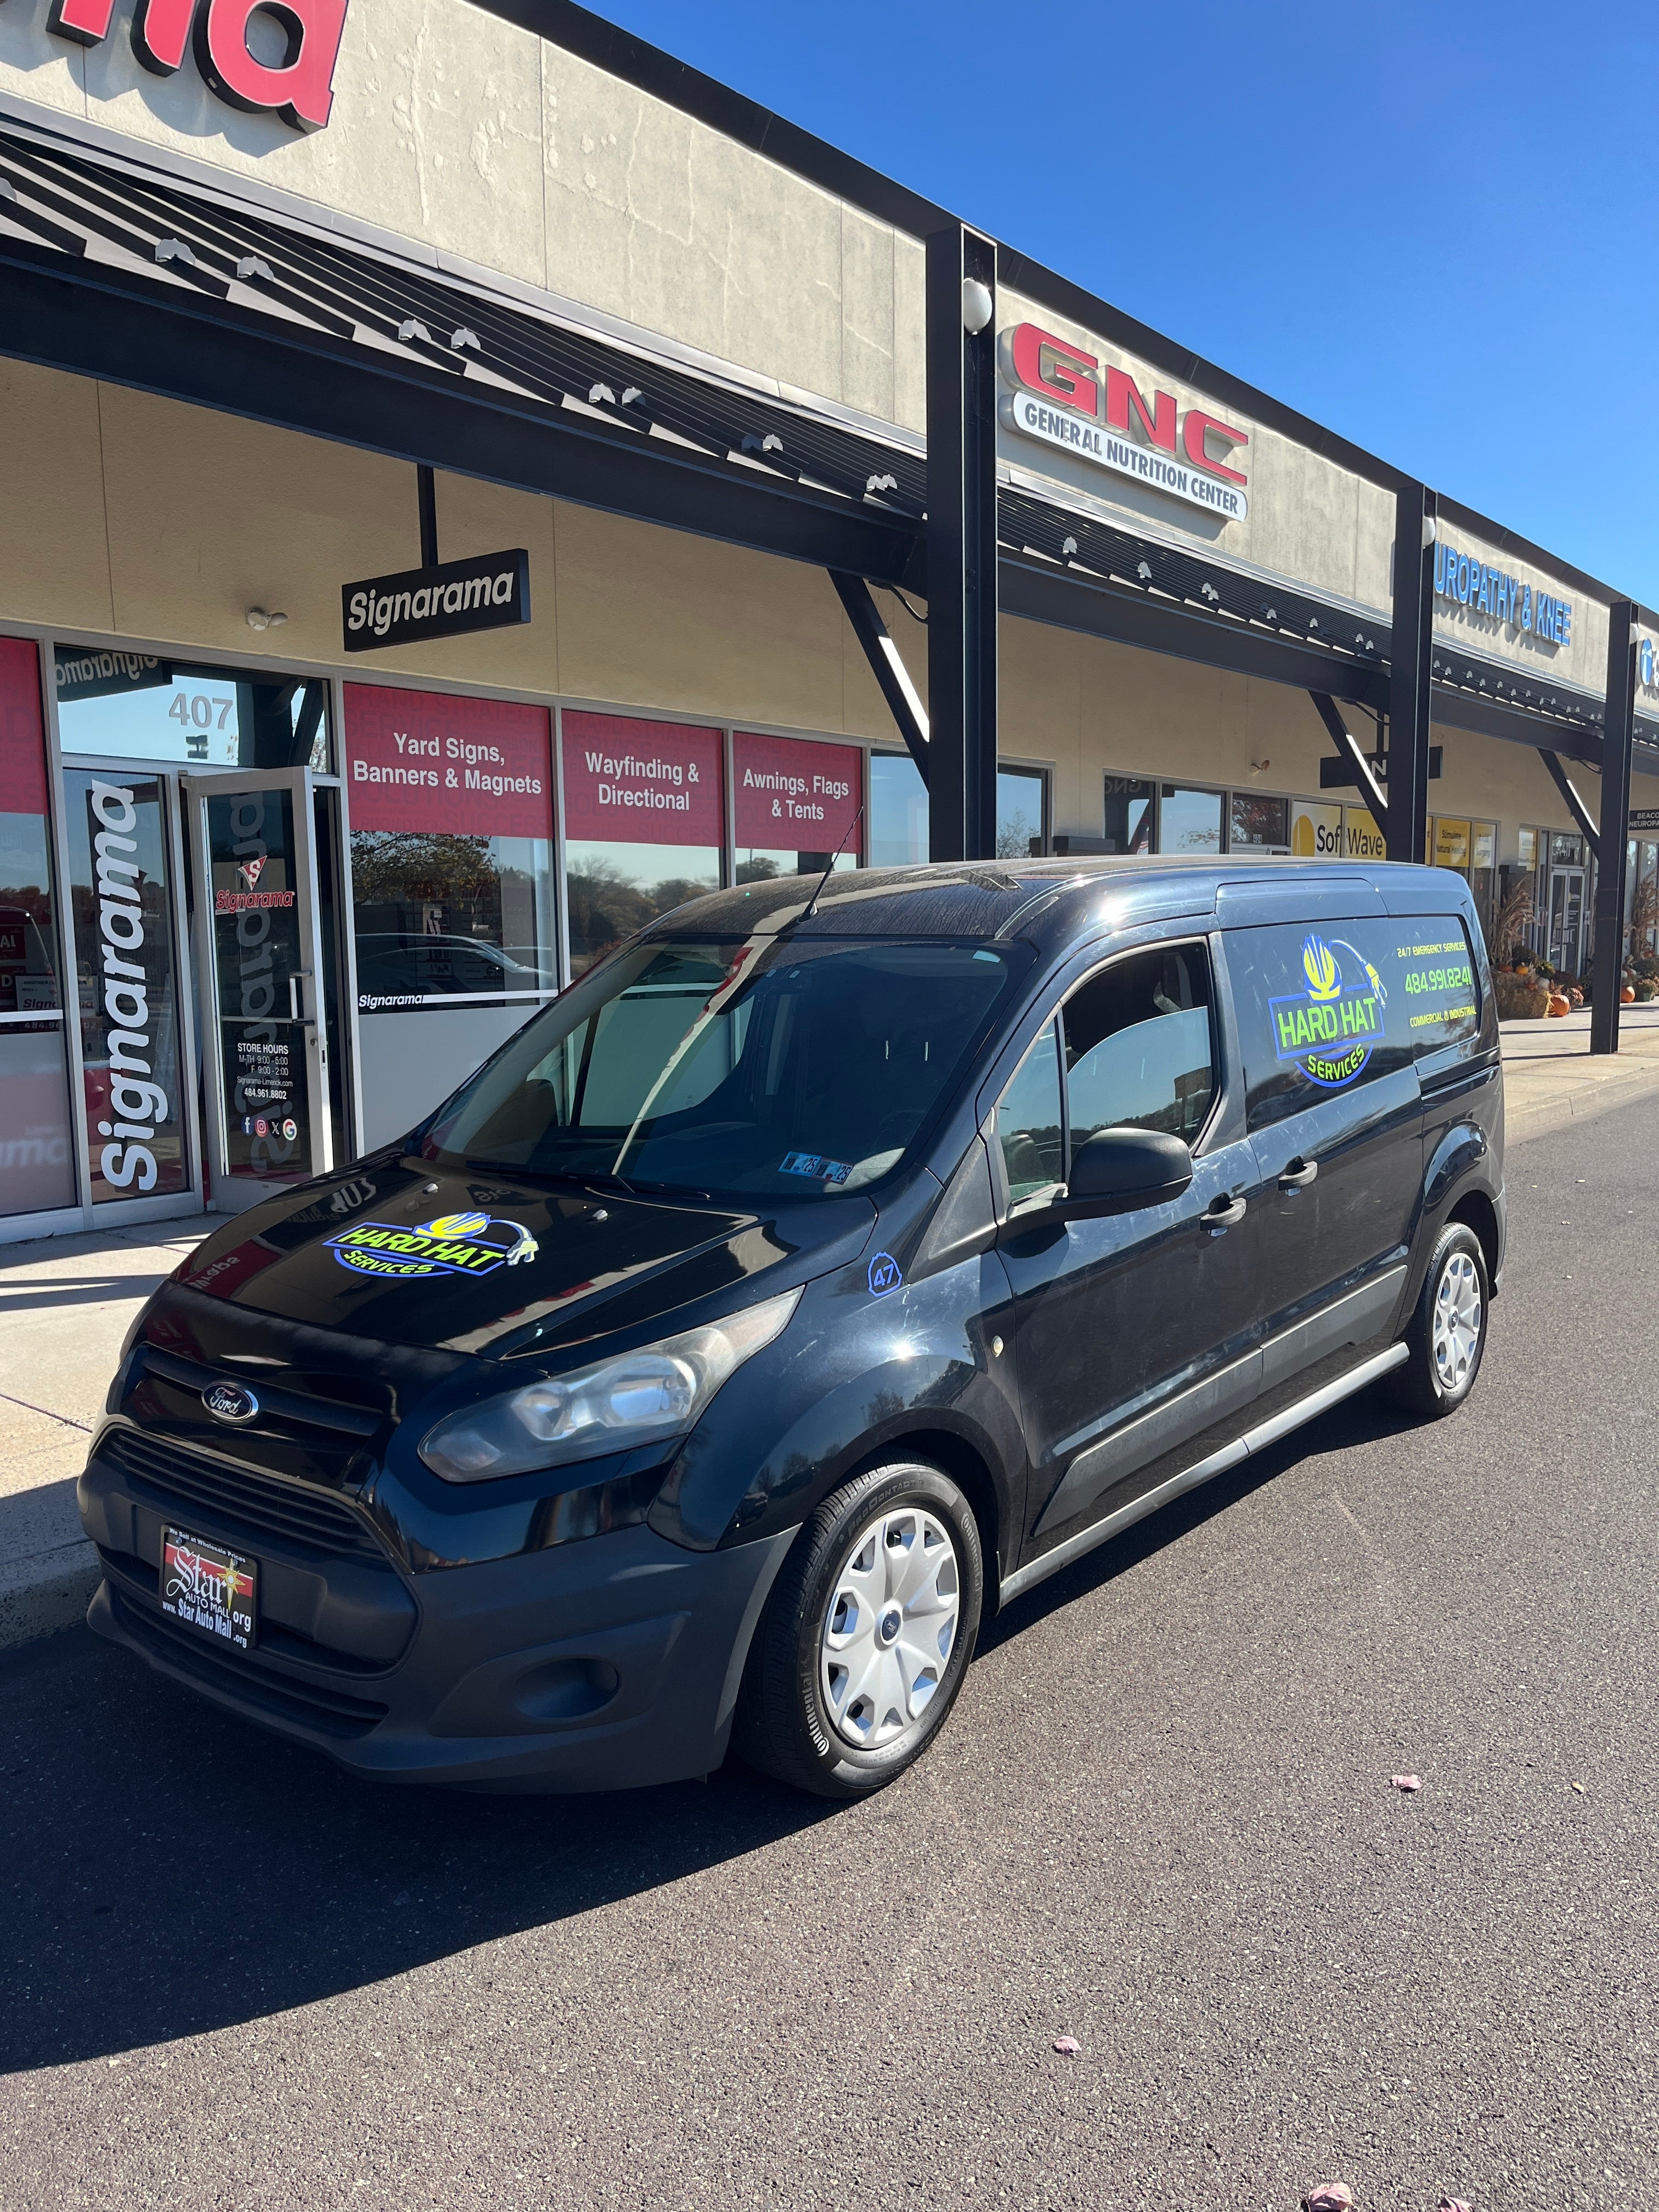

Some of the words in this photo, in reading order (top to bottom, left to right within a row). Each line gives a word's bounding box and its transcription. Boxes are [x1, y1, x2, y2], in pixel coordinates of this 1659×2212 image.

[1011, 323, 1249, 487] GNC
[1024, 402, 1102, 456] GENERAL
[1107, 438, 1188, 492] NUTRITION
[1190, 477, 1238, 515] CENTER
[347, 571, 515, 636] Signarama
[1521, 584, 1532, 631] &
[1536, 590, 1572, 647] KNEE
[168, 692, 233, 730] 407
[393, 731, 441, 758] Yard
[445, 737, 506, 766] Signs,
[353, 759, 439, 787] Banners
[444, 768, 460, 789] &
[465, 769, 542, 797] Magnets
[584, 751, 683, 786] Wayfinding
[687, 761, 701, 783] &
[598, 783, 691, 811] Directional
[742, 768, 810, 797] Awnings,
[812, 775, 850, 800] Flags
[771, 798, 783, 818] &
[785, 799, 825, 821] Tents
[216, 889, 294, 914] Signarama
[1396, 946, 1411, 958] 24/7
[1412, 943, 1442, 956] EMERGENCY
[1443, 941, 1466, 952] SERVICES
[91, 778, 168, 1191] Signarama
[1405, 966, 1472, 995] 484.991.8241
[358, 994, 424, 1010] Signarama
[1277, 1005, 1338, 1048] HARD
[1339, 997, 1376, 1036] HAT
[1409, 1012, 1443, 1028] COMMERCIAL
[1449, 1005, 1477, 1019] INDUSTRIAL
[238, 1043, 262, 1053] STORE
[262, 1043, 289, 1055] HOURS
[239, 1054, 256, 1064] M-TH
[257, 1055, 270, 1065] 9:00
[275, 1056, 289, 1065] 5:00
[1307, 1043, 1365, 1081] SERVICES
[251, 1064, 256, 1074] F
[257, 1065, 271, 1075] 9:00
[275, 1066, 289, 1076] 2:00
[244, 1087, 287, 1100] 484.961.8802
[803, 1157, 819, 1173] 25
[836, 1165, 852, 1181] 25
[337, 1228, 432, 1253] HARD
[420, 1241, 505, 1268] HAT
[343, 1249, 436, 1274] SERVICES
[873, 1263, 894, 1288] 47
[210, 1387, 242, 1414] Ford
[169, 1527, 178, 1536] We
[179, 1531, 190, 1541] Sell
[196, 1538, 227, 1556] Wholesale
[227, 1550, 246, 1564] Prices
[166, 1545, 227, 1604] Star
[185, 1592, 209, 1609] AUTO
[210, 1601, 230, 1619] MALL
[162, 1600, 177, 1615] www.
[178, 1597, 195, 1622] Star
[195, 1605, 215, 1631] Auto
[215, 1613, 232, 1639] Mall
[233, 1633, 247, 1649] .org
[232, 1610, 252, 1633] org
